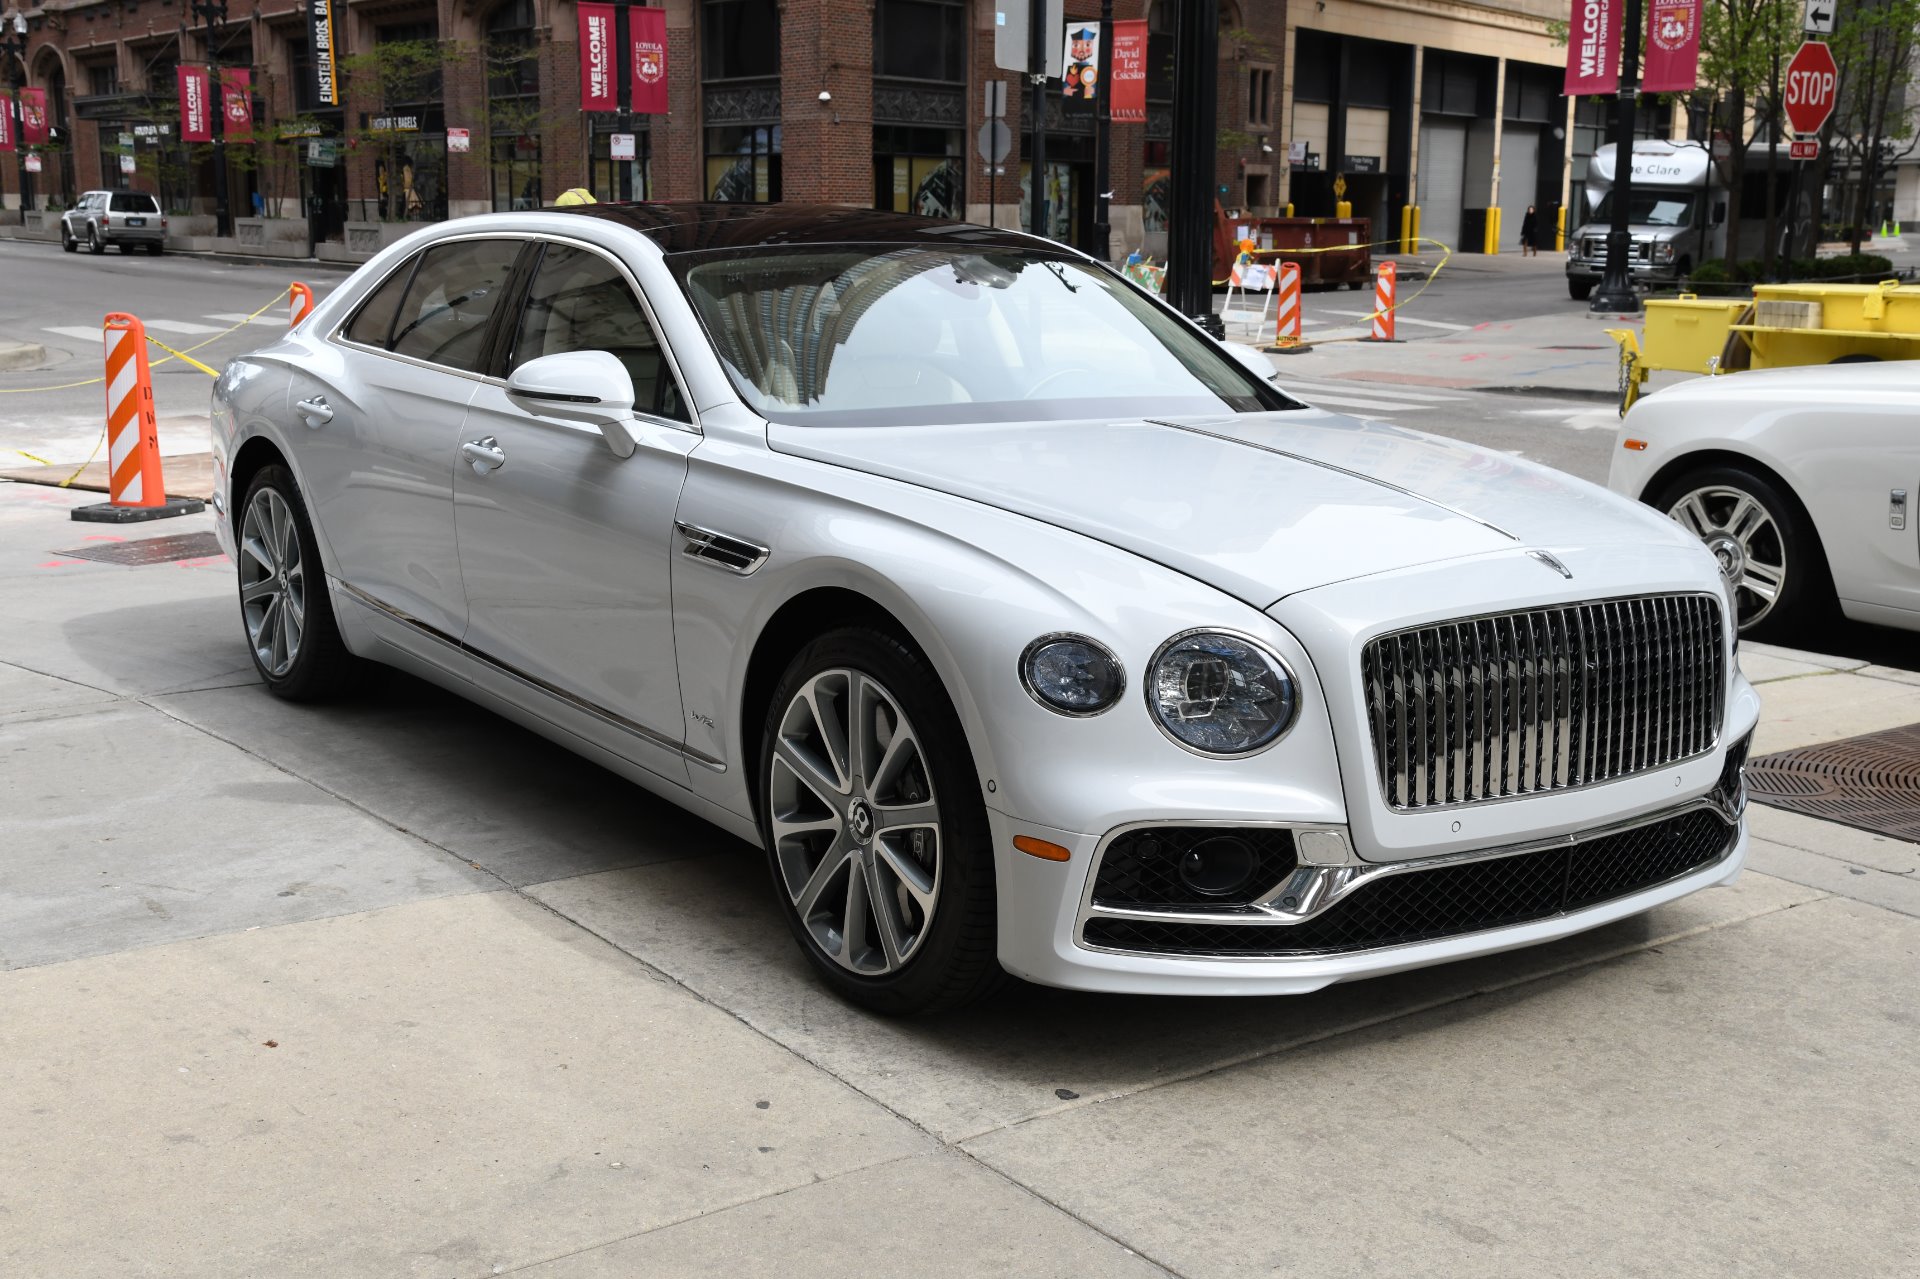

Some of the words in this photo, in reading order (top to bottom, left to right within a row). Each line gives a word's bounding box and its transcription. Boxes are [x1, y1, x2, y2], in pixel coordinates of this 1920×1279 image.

[1599, 12, 1609, 45] TOWER
[588, 16, 602, 98] WELCOME
[635, 42, 663, 51] LOYOLA
[1115, 48, 1139, 59] David
[1597, 46, 1606, 77] WATER
[319, 52, 332, 103] EINSTEIN
[1124, 59, 1139, 69] Lee
[186, 75, 198, 132] WELCOME
[1788, 71, 1834, 106] STOP
[1647, 164, 1681, 176] Clare
